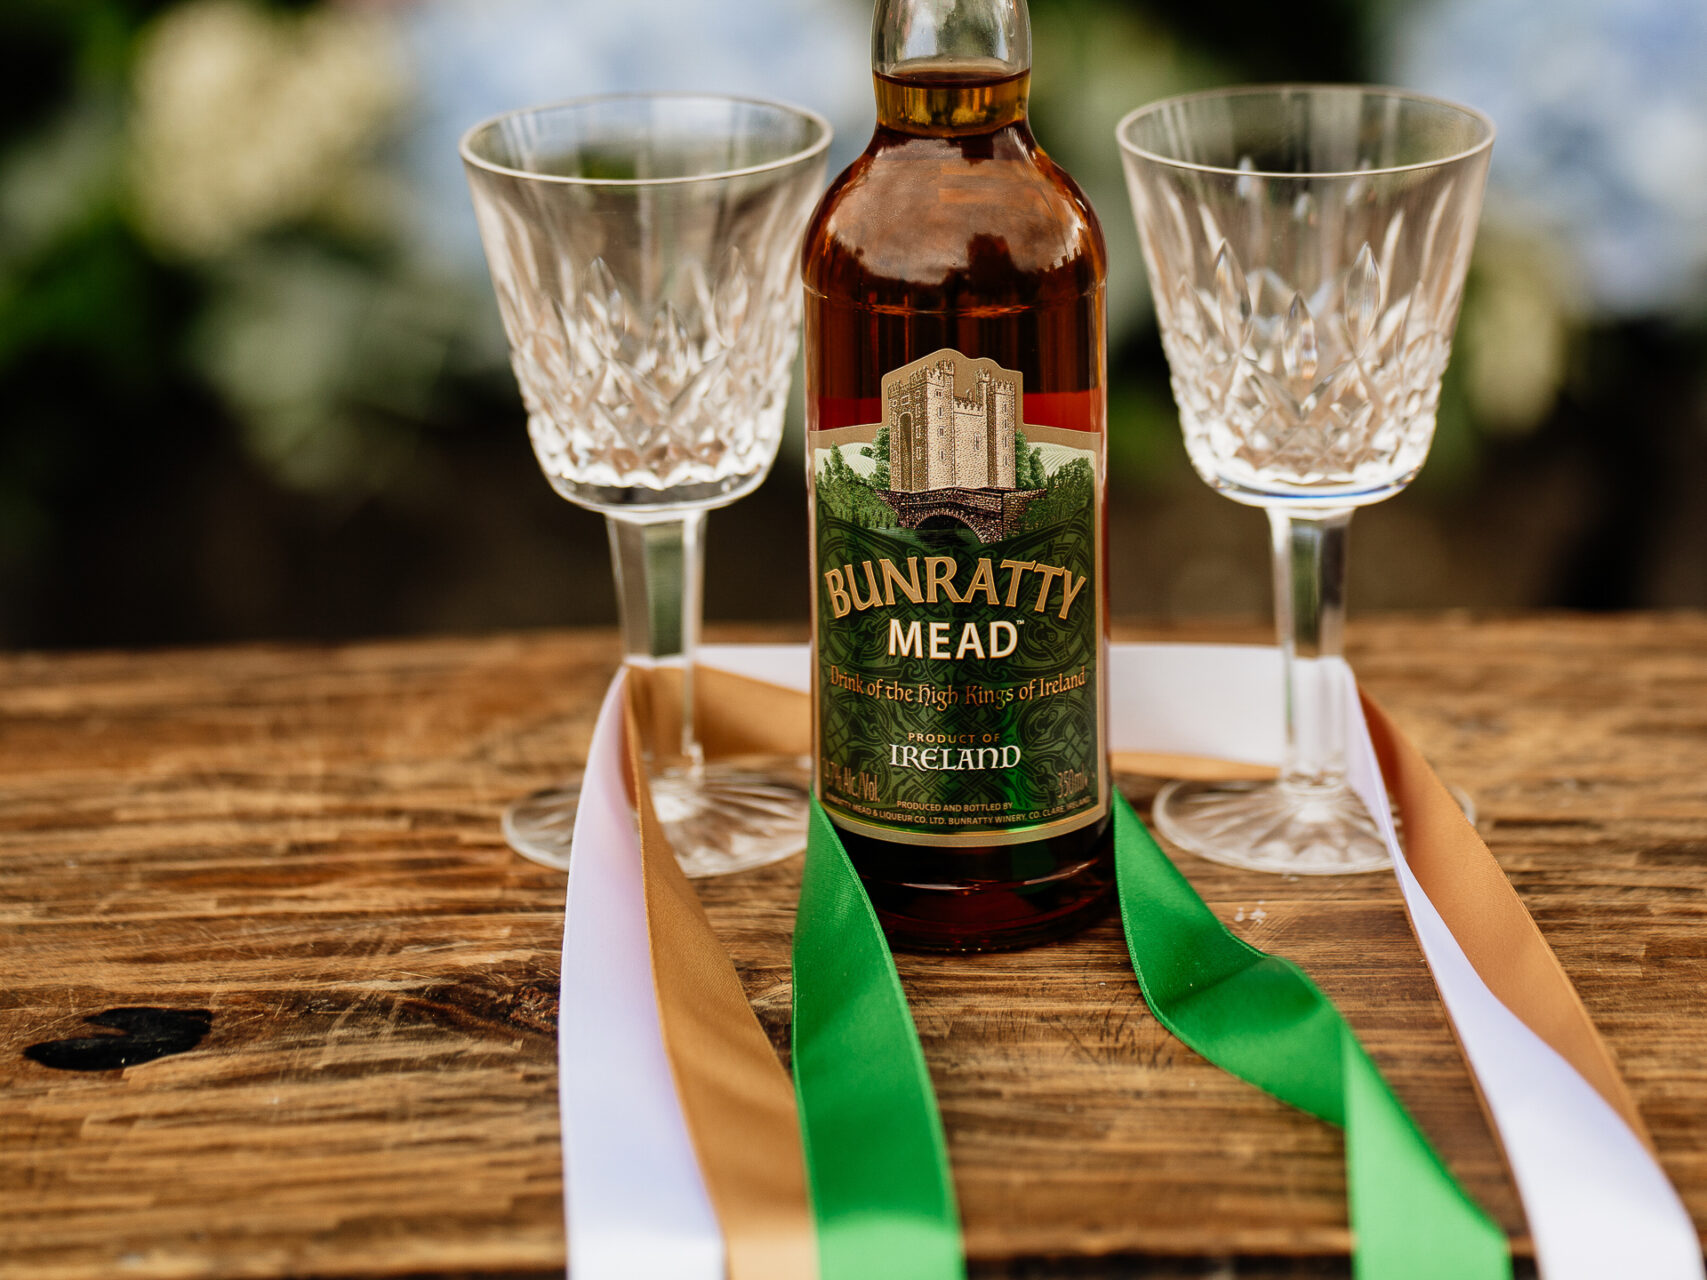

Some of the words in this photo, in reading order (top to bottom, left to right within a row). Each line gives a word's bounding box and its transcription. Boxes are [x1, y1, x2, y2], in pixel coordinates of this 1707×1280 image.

[824, 556, 1087, 620] BUNRATTY
[830, 664, 864, 694] Drink
[867, 679, 884, 699] of
[885, 681, 914, 703] the
[918, 683, 959, 712] High
[965, 685, 1014, 710] Kings
[1019, 678, 1037, 701] of
[1039, 665, 1086, 697] Ireland
[908, 732, 976, 744] PRODUCT
[982, 733, 1000, 743] OF
[889, 743, 1021, 772] IRELAND
[896, 800, 942, 812] PRODUCED
[943, 804, 962, 812] AND
[963, 803, 1001, 812] BOTTLED
[1003, 802, 1013, 810] BY
[879, 810, 913, 822] LIQUEUR
[948, 816, 993, 825] BUNRATTY
